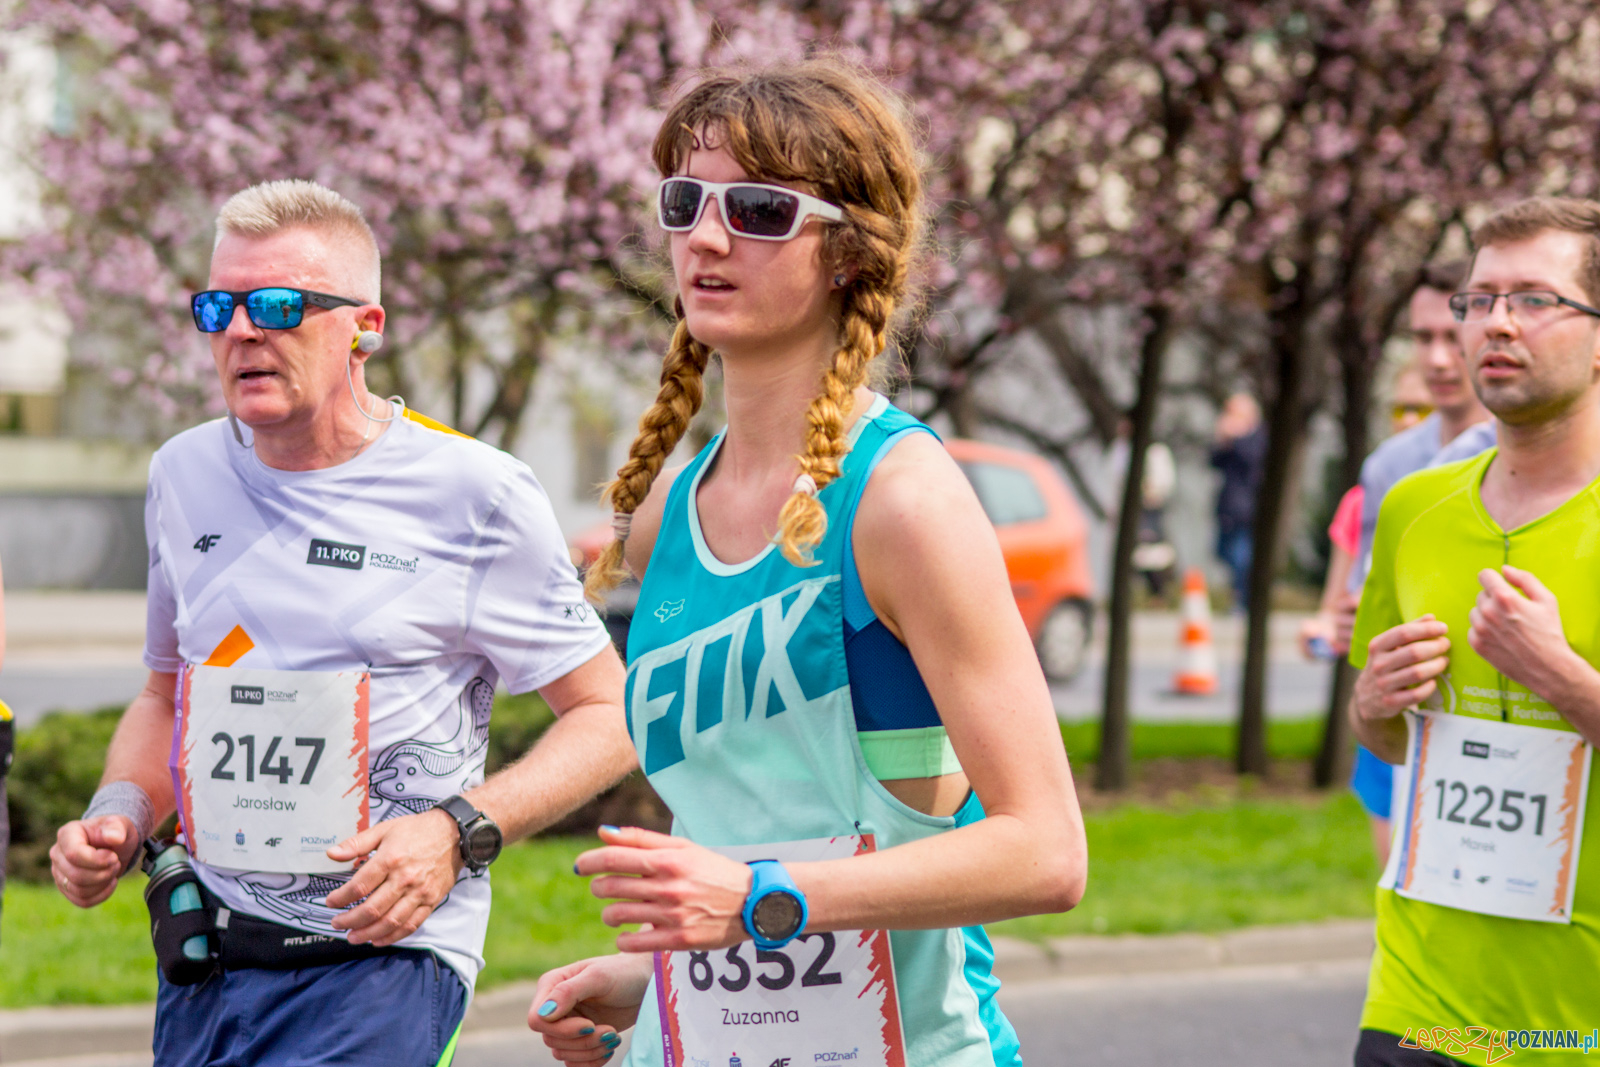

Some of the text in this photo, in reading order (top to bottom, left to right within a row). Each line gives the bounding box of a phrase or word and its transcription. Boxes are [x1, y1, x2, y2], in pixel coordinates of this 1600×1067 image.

[193, 534, 221, 553] 4F
[627, 574, 842, 777] FOX
[211, 731, 326, 785] 2147
[232, 794, 297, 812] Jarosław
[1435, 779, 1548, 836] 12251
[264, 837, 282, 847] 4F
[1461, 836, 1497, 853] Marek
[688, 932, 842, 992] 8352
[721, 1007, 800, 1025] Zuzanna
